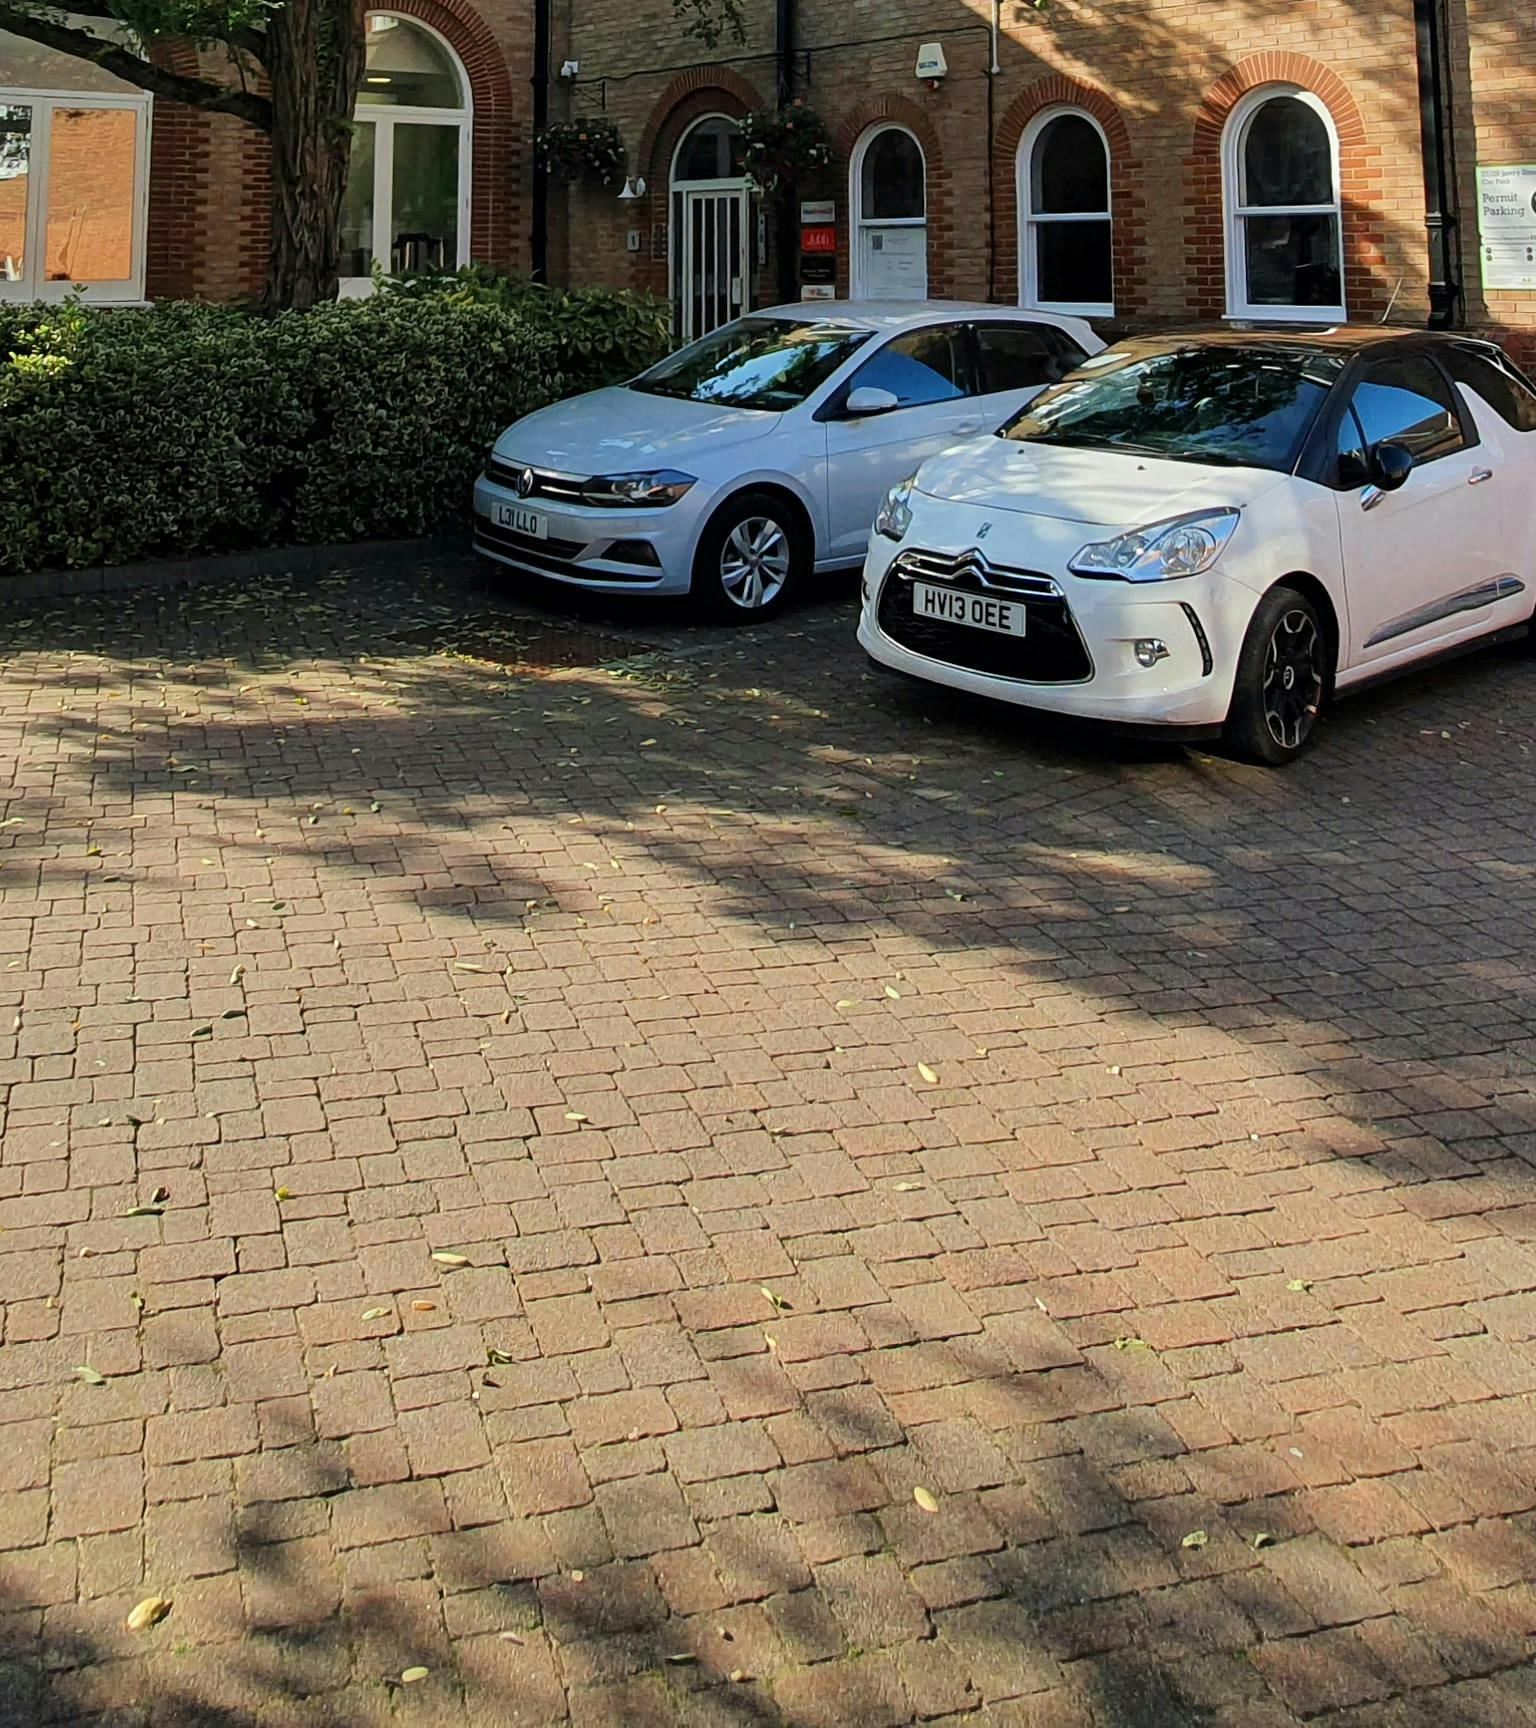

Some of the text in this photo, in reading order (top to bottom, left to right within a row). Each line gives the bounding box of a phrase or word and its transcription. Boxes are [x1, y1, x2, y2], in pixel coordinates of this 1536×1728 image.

[1482, 192, 1518, 203] Permit
[1483, 206, 1526, 218] Parking
[924, 589, 1012, 631] HV13 OEE
